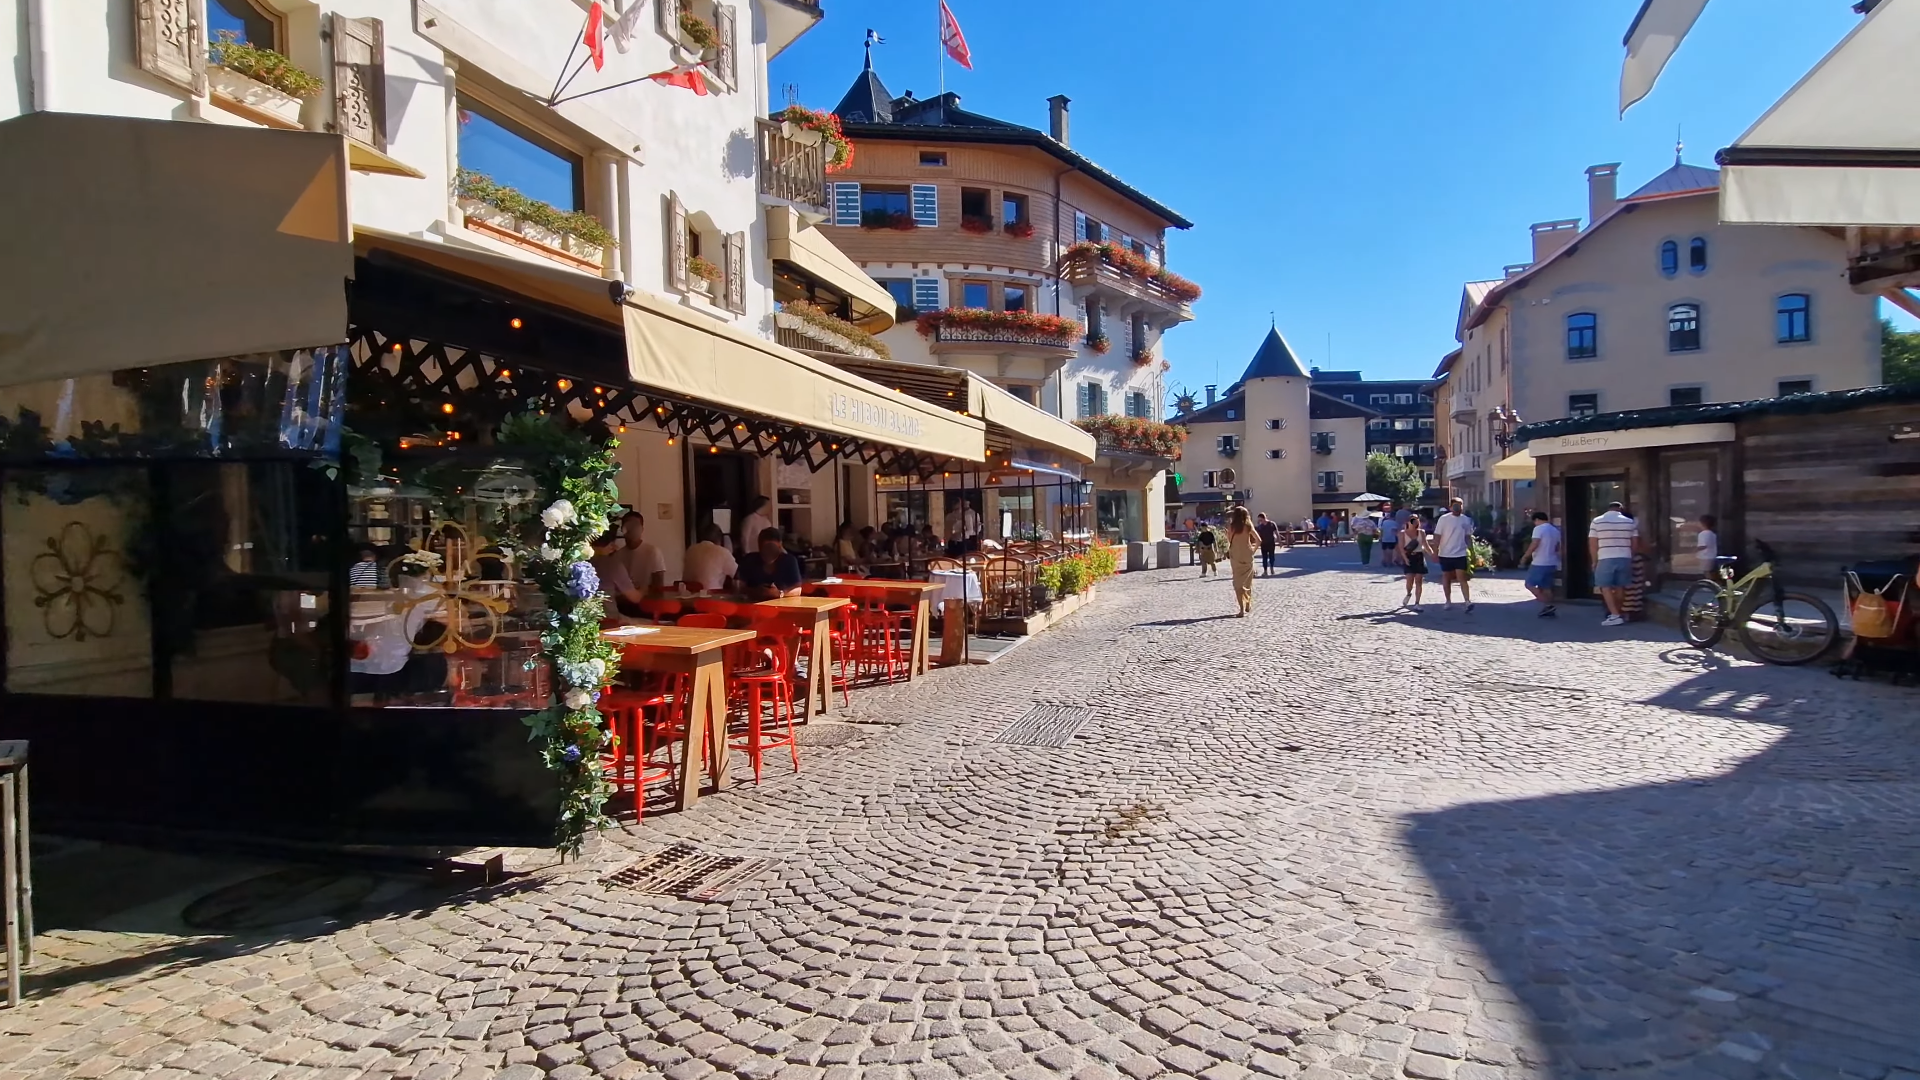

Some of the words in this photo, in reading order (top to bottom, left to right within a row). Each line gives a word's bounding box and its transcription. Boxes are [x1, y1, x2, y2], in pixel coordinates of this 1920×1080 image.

[832, 393, 847, 419] LE
[850, 398, 887, 428] HIBOU
[889, 410, 920, 437] BLANC
